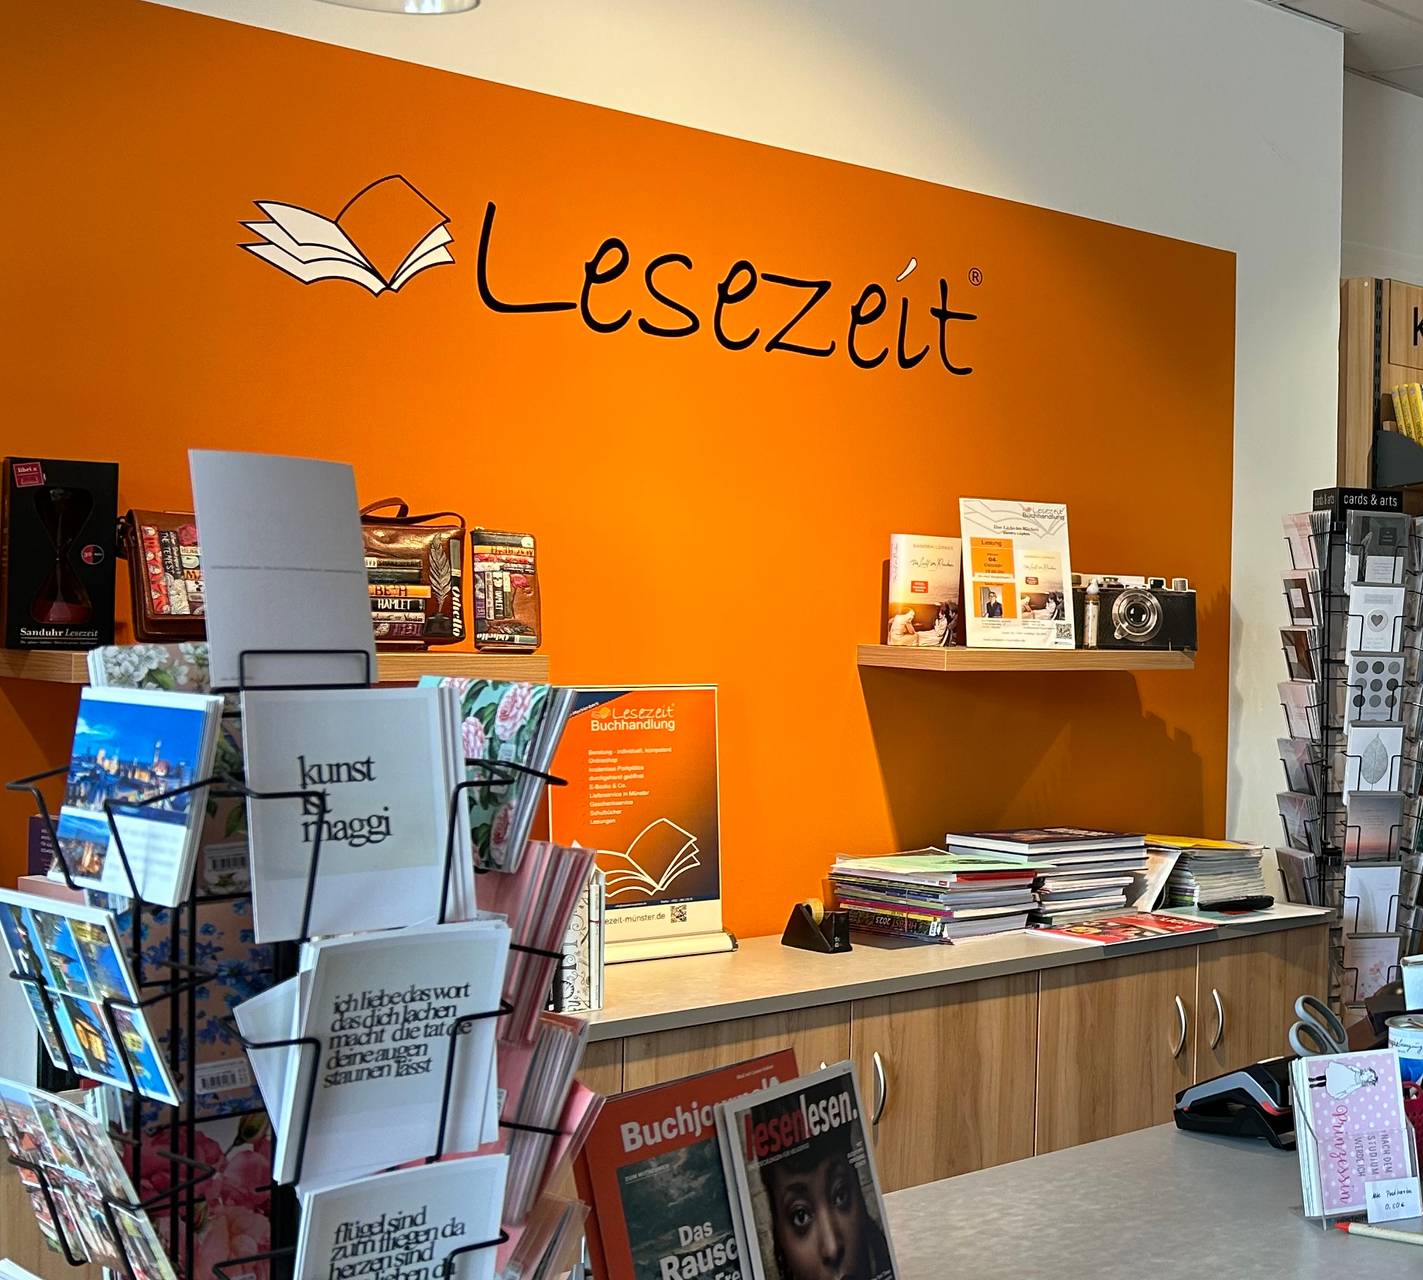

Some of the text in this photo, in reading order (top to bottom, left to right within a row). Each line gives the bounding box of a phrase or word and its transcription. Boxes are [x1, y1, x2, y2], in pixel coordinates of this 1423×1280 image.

[476, 201, 978, 375] Lesezeit
[1344, 494, 1368, 506] cards
[1371, 494, 1378, 506] &
[1380, 495, 1398, 507] arts
[378, 599, 412, 610] HAMLET
[452, 586, 464, 637] Othello
[20, 627, 98, 638] Sanduhr Lesezeit
[591, 719, 675, 732] Buchhandlung
[613, 705, 673, 719] Lesezeit
[298, 754, 376, 790] kunst
[302, 806, 393, 848] maggi
[605, 913, 665, 925] ezeit-münster.de
[334, 982, 471, 1014] ich liebe das wort
[331, 1001, 457, 1033] das dich lachen
[329, 1029, 384, 1050] macht
[392, 1023, 423, 1043] die
[423, 1020, 445, 1039] tat
[323, 1057, 432, 1088] staunen lässt
[326, 1043, 428, 1070] deine augen
[1329, 1104, 1352, 1204] Prinzessin
[1367, 1135, 1380, 1175] STUDIUM
[1381, 1134, 1393, 1174] NACH DEM
[331, 1217, 466, 1261] zum fliegen da
[335, 1205, 427, 1245] flügel sind
[678, 1221, 713, 1247] Das
[329, 1241, 434, 1280] herzen sind
[660, 1237, 739, 1280] Rausc
